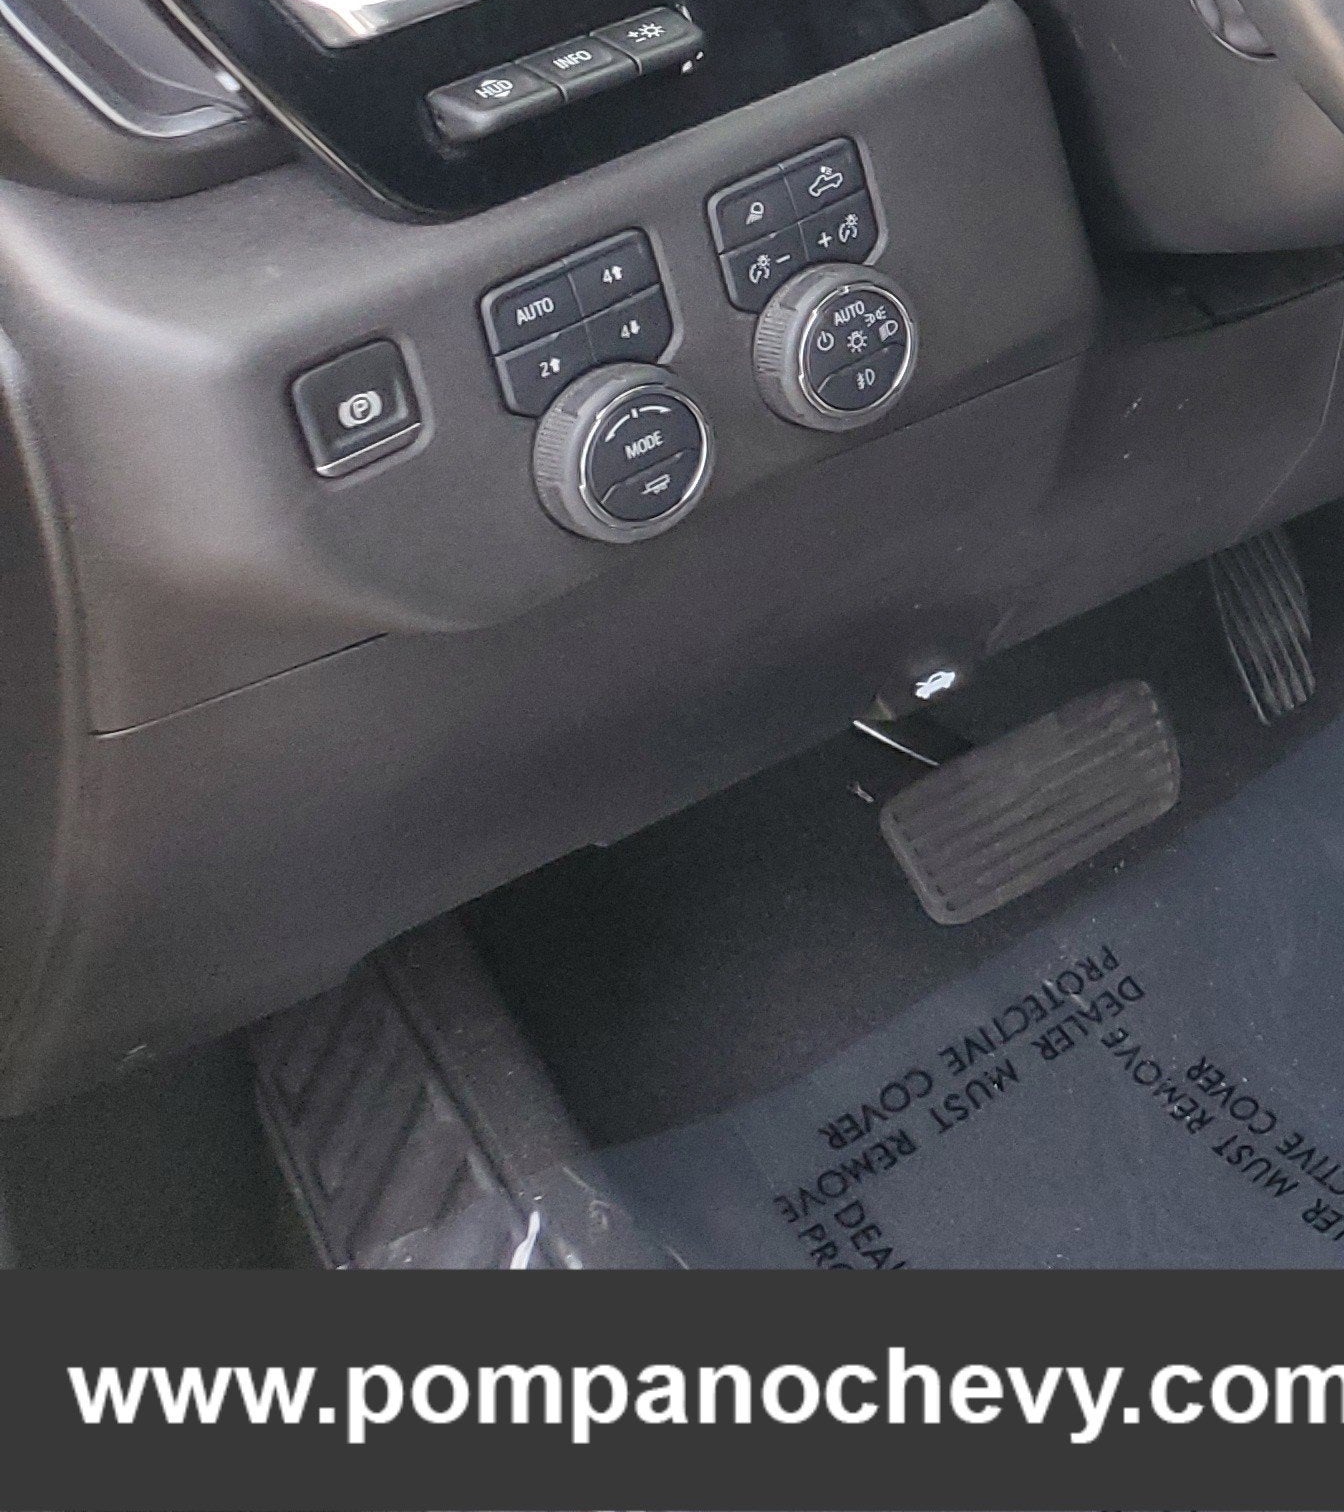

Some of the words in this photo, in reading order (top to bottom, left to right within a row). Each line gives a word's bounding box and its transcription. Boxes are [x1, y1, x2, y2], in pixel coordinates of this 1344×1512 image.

[474, 79, 514, 99] HUD
[552, 49, 593, 70] INFO
[516, 297, 555, 326] AUTO
[833, 300, 866, 327] AUTO
[624, 430, 664, 460] MODE
[936, 944, 1121, 1078] PROTECTIVE
[1030, 974, 1146, 1062] DEALER
[816, 1067, 934, 1151] COVER
[929, 1058, 1021, 1135] MUST
[1101, 1027, 1215, 1135] REMOVE
[1186, 1056, 1278, 1136] COVER
[772, 1129, 918, 1224] REMOVE
[1211, 1134, 1300, 1199] MUST
